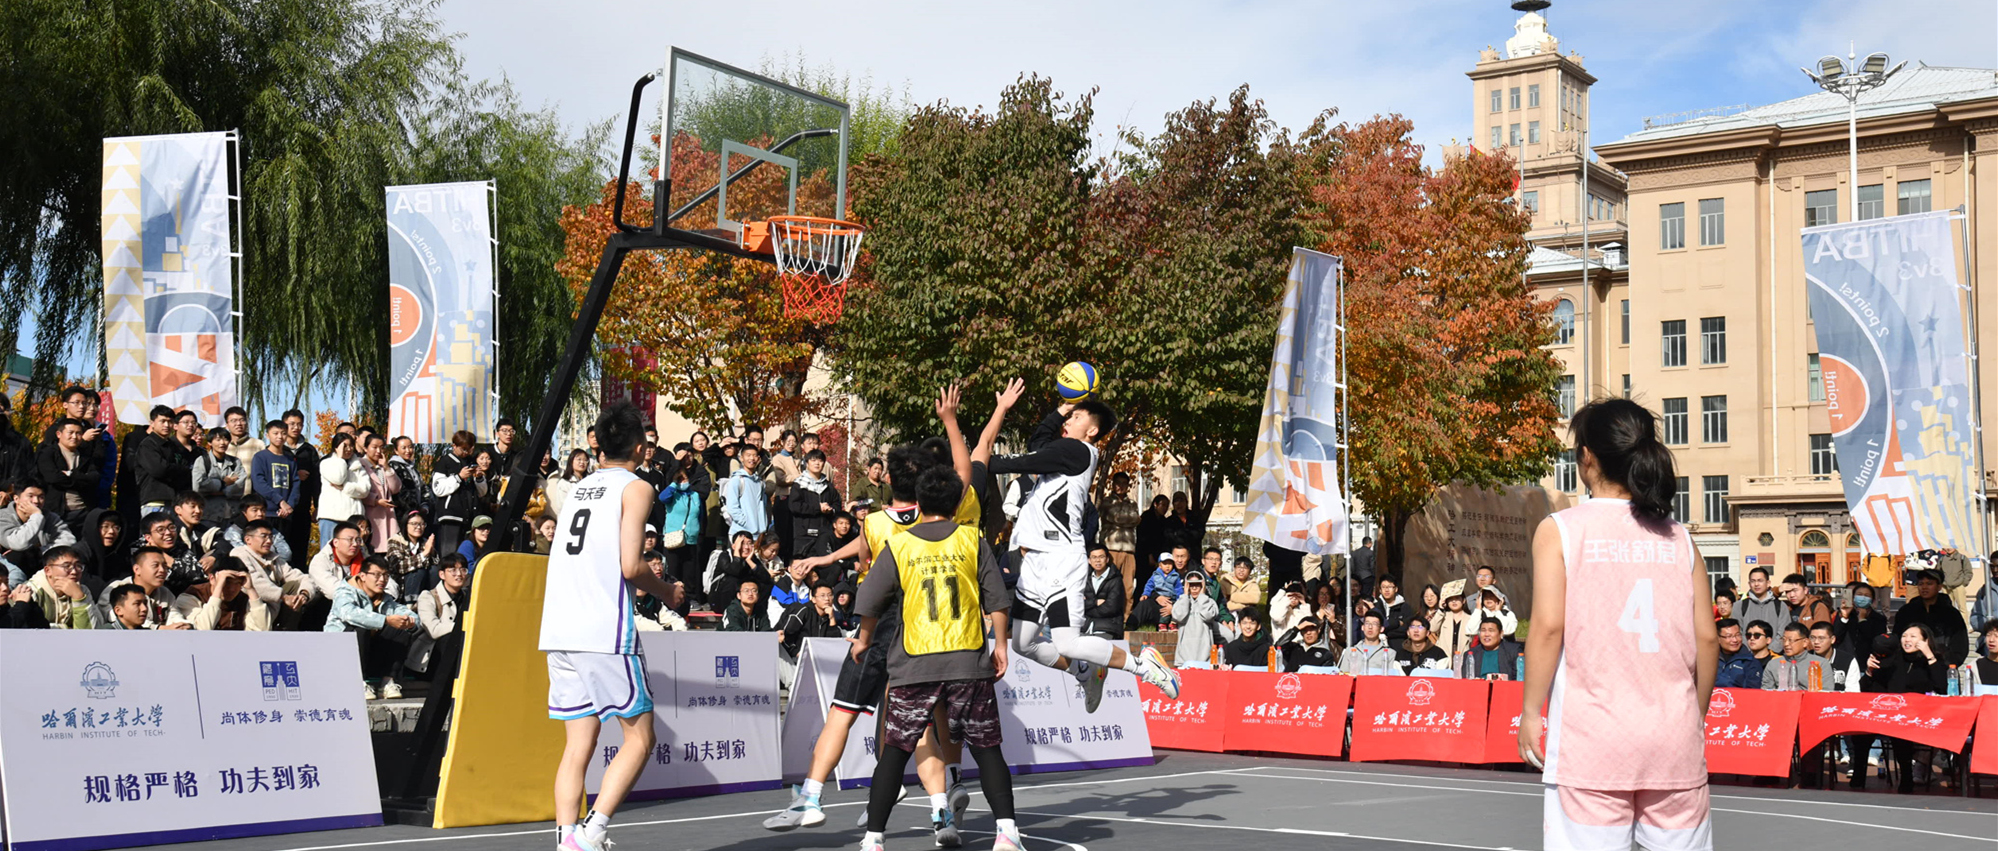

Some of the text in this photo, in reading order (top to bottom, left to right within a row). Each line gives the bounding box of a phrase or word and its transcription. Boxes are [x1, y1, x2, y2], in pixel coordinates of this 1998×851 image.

[566, 508, 591, 556] 9
[921, 575, 962, 622] 11
[1617, 578, 1660, 653] 4
[221, 710, 283, 725] 尚体修身
[42, 732, 74, 740] HARBIN
[81, 730, 121, 739] INSTITUTE
[684, 739, 746, 762] 功夫到家
[1024, 724, 1124, 745] 规格严格 功夫到家
[84, 763, 320, 804] 规格严格 功夫到家
